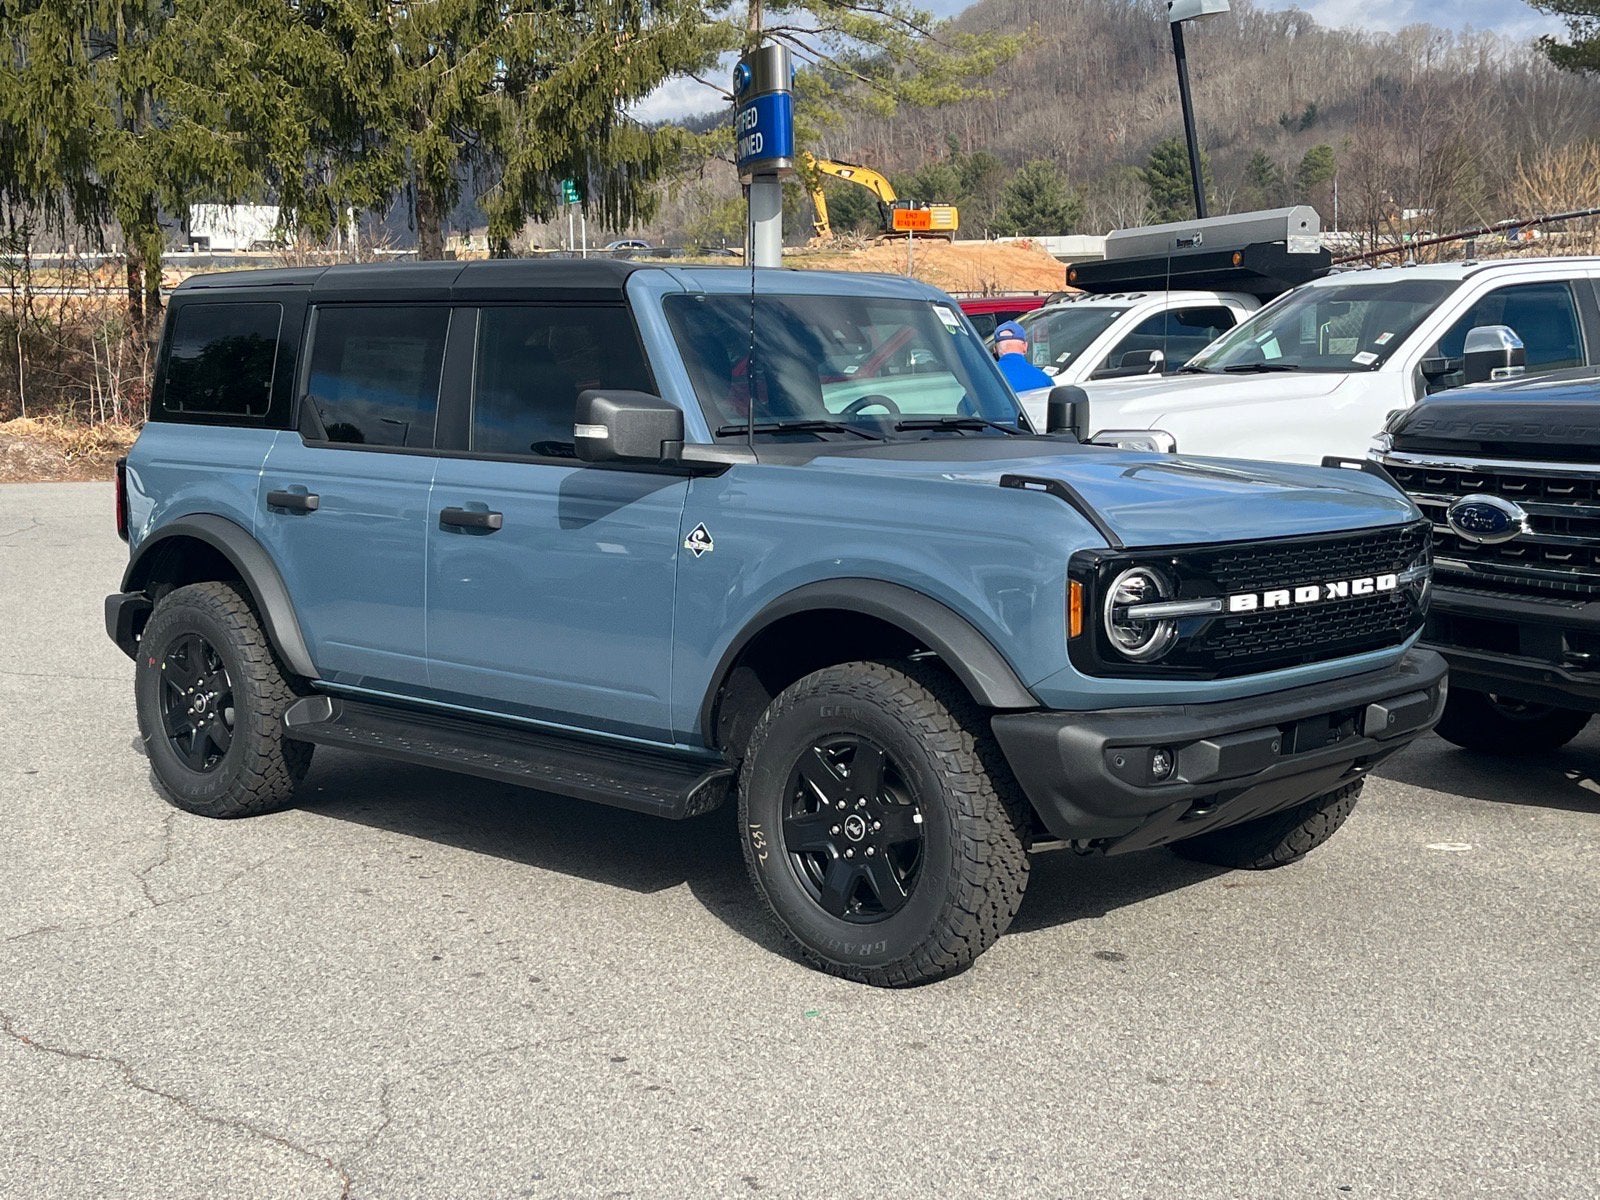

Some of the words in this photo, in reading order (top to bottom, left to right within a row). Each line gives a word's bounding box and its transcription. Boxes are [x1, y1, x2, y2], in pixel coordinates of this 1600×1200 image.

[1414, 419, 1513, 436] SUPER
[1517, 423, 1600, 440] DUT
[1460, 507, 1498, 529] Ford
[1229, 573, 1397, 612] BRONCO
